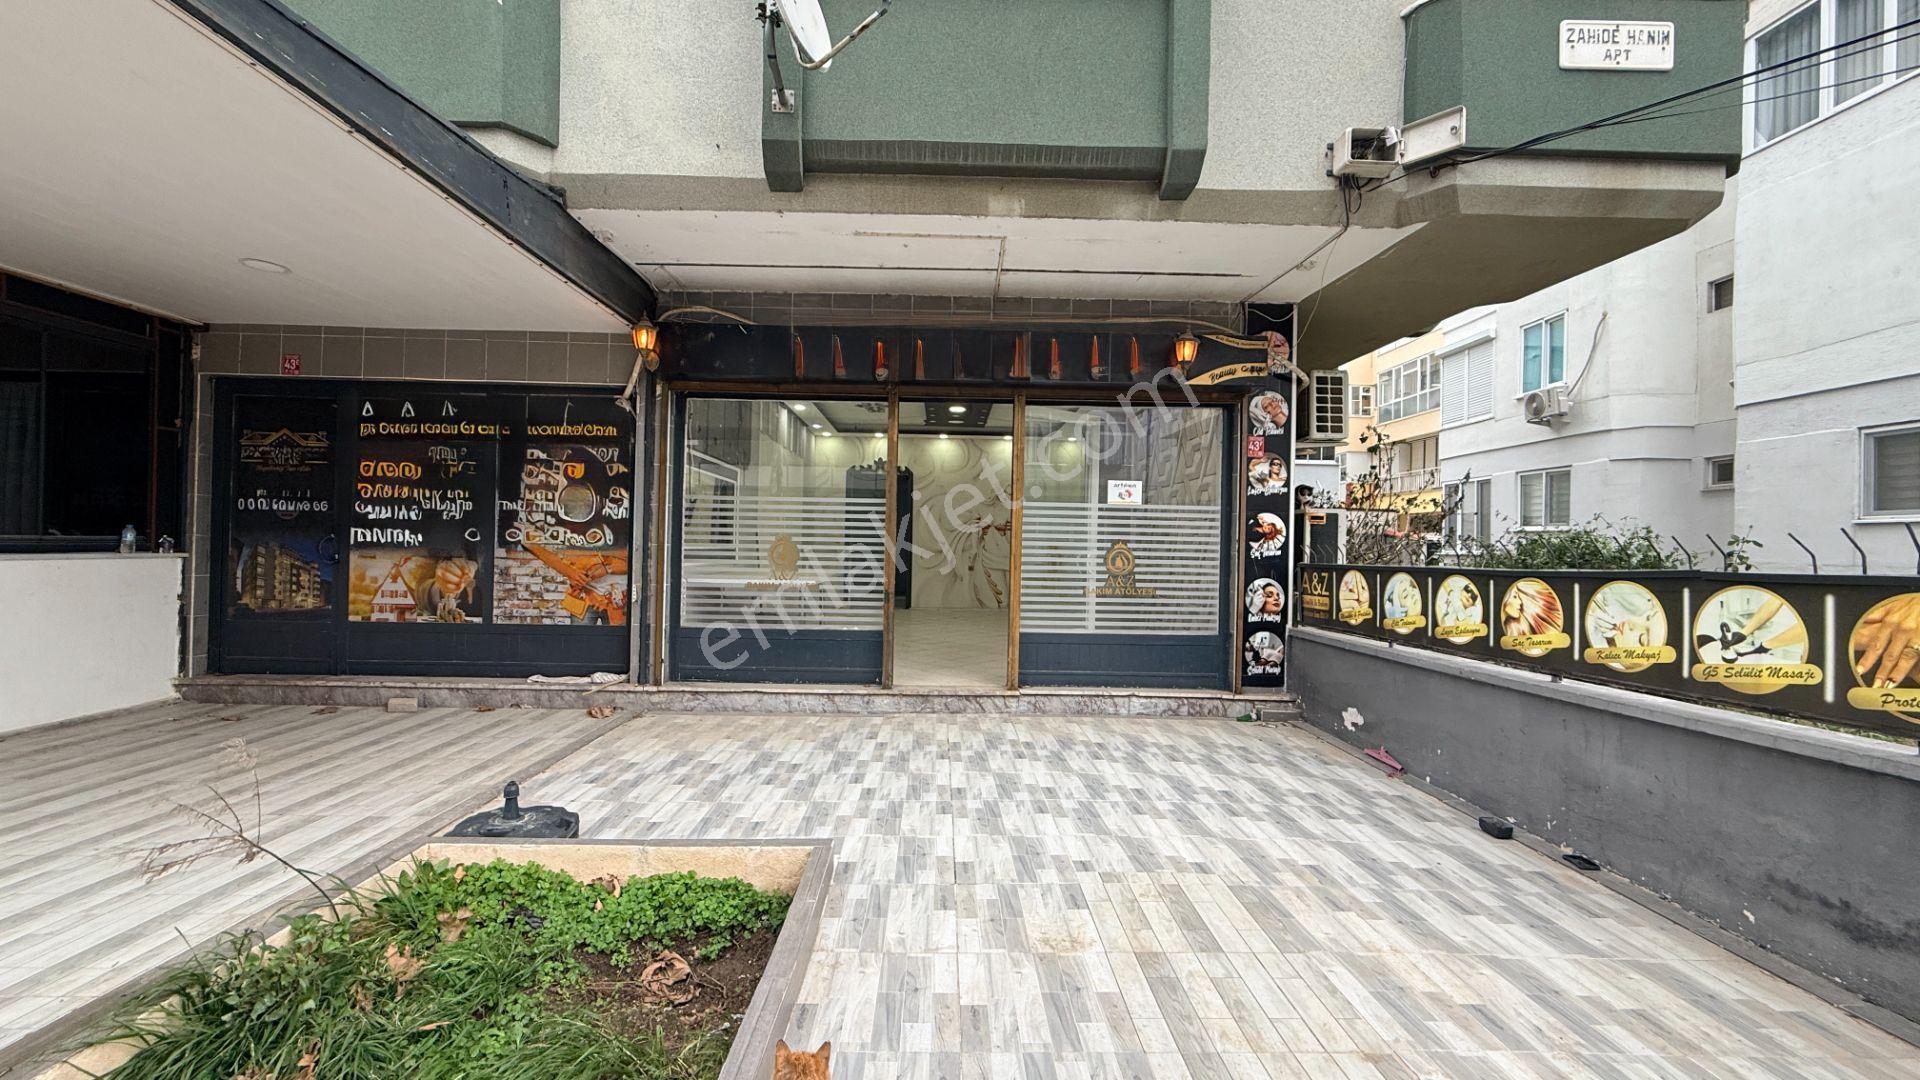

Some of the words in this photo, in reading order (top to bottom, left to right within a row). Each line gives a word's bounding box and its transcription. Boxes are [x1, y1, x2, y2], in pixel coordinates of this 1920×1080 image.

[1603, 48, 1631, 61] APT
[1511, 637, 1525, 647] Saç
[1623, 650, 1662, 661] Makyaj
[1703, 666, 1718, 678] G5
[1723, 665, 1763, 678] Selülit
[1765, 666, 1816, 682] Masajı
